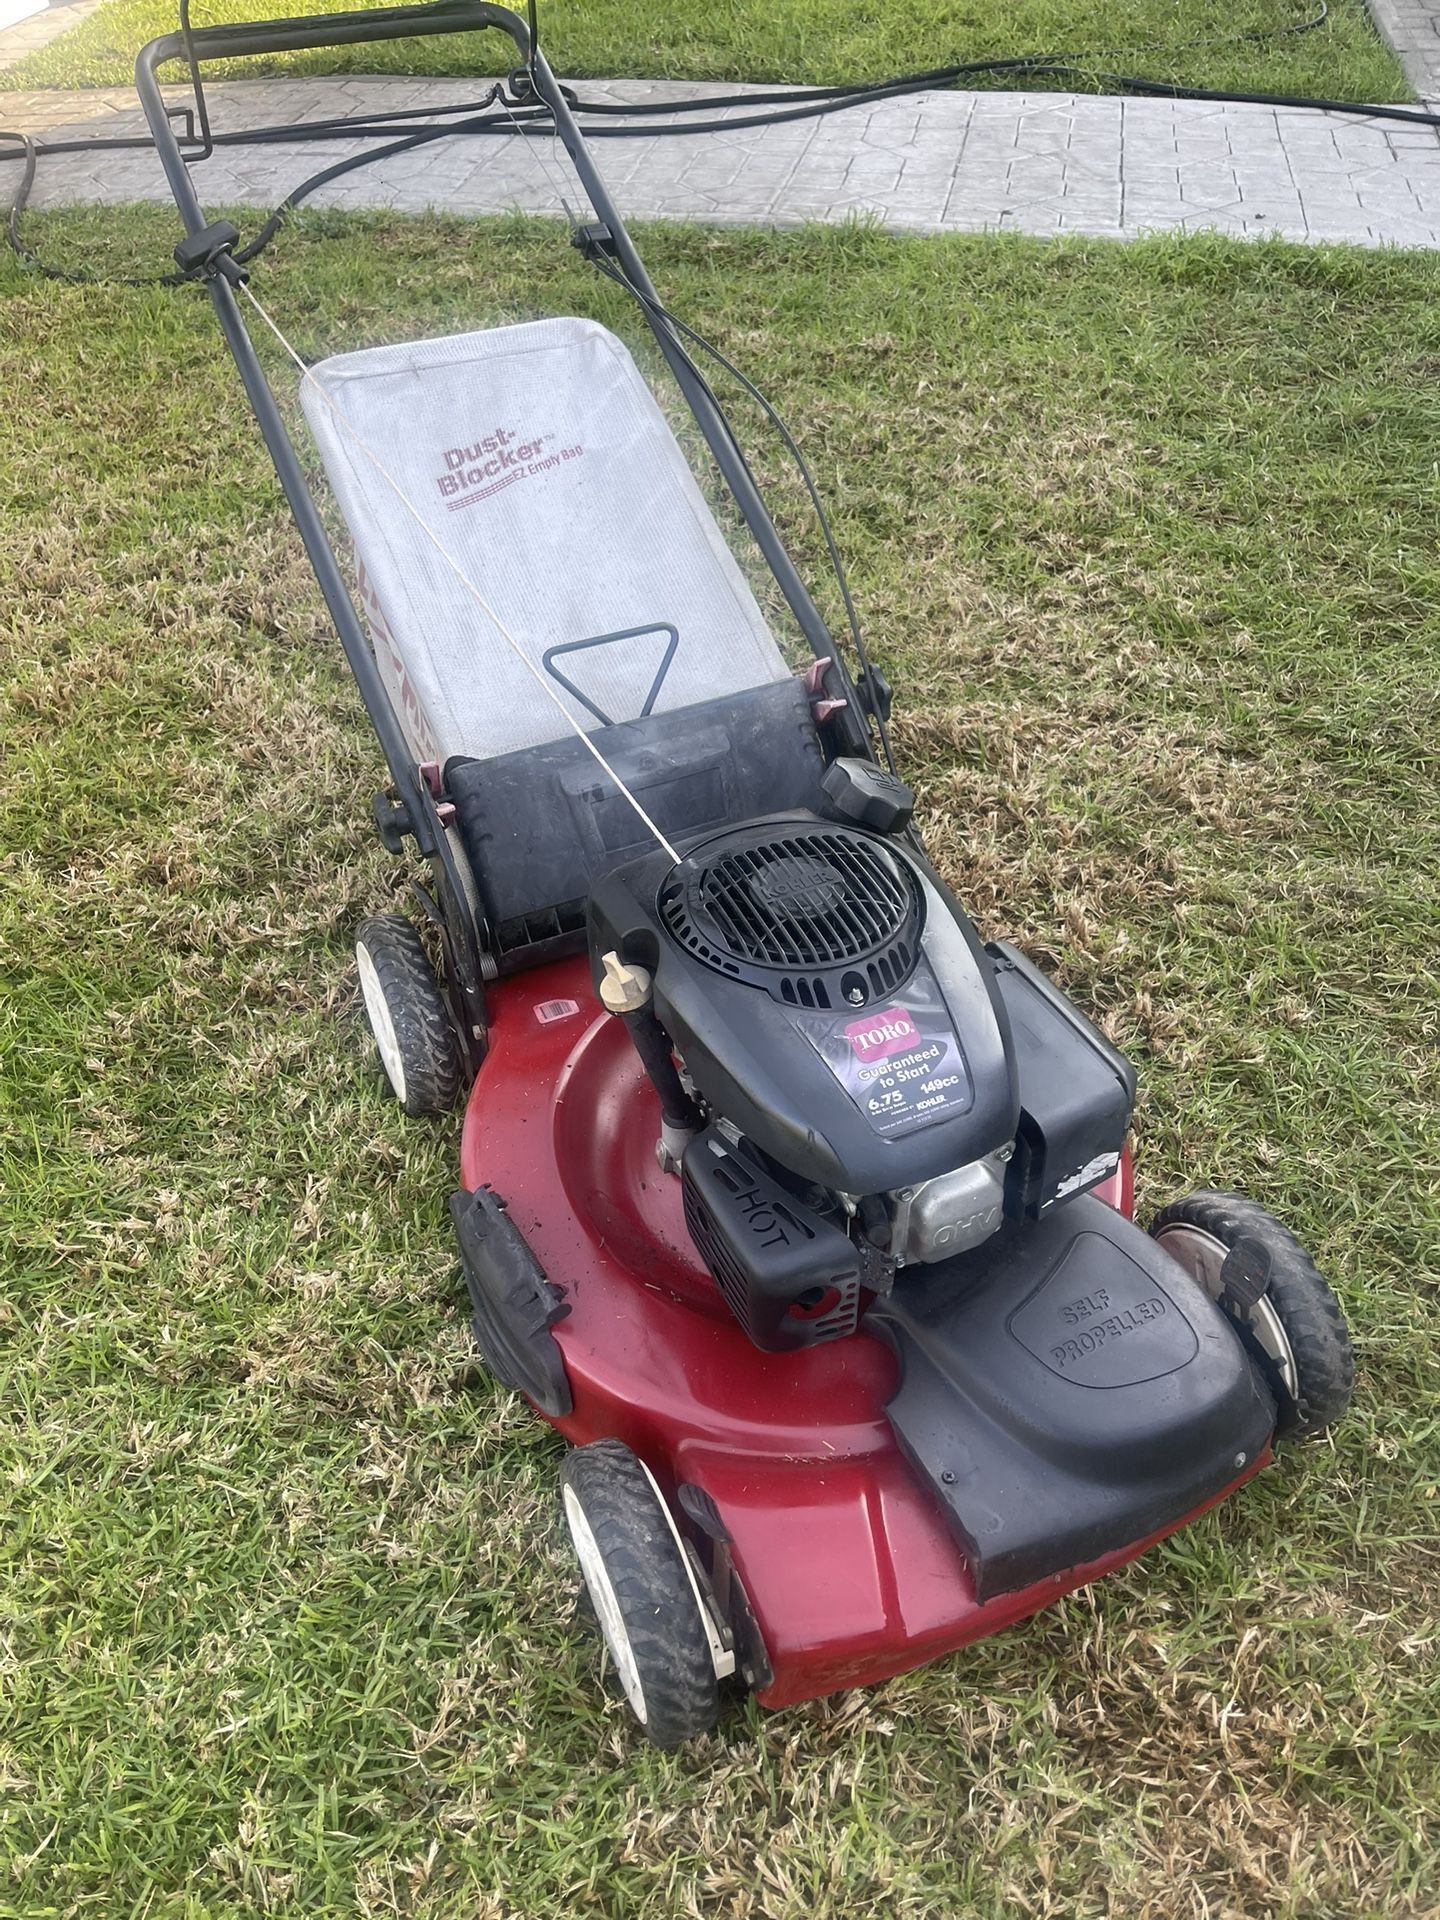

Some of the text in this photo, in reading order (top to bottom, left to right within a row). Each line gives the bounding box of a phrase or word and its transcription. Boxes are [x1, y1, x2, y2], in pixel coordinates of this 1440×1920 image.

[436, 438, 543, 497] Blocker
[442, 427, 515, 471] Dust-
[512, 444, 584, 481] EZ Empty Bag
[761, 871, 834, 899] KOHLER
[858, 1045, 940, 1081] Guaranteed
[879, 1063, 931, 1089] to Start
[868, 1089, 903, 1111] 6.75
[915, 1094, 947, 1111] KOHLER
[919, 1074, 960, 1094] 149cc
[735, 1188, 791, 1248] HOT
[932, 1206, 999, 1247] OHV
[1062, 1288, 1110, 1325] SELF
[1050, 1297, 1166, 1368] PROPELLED
